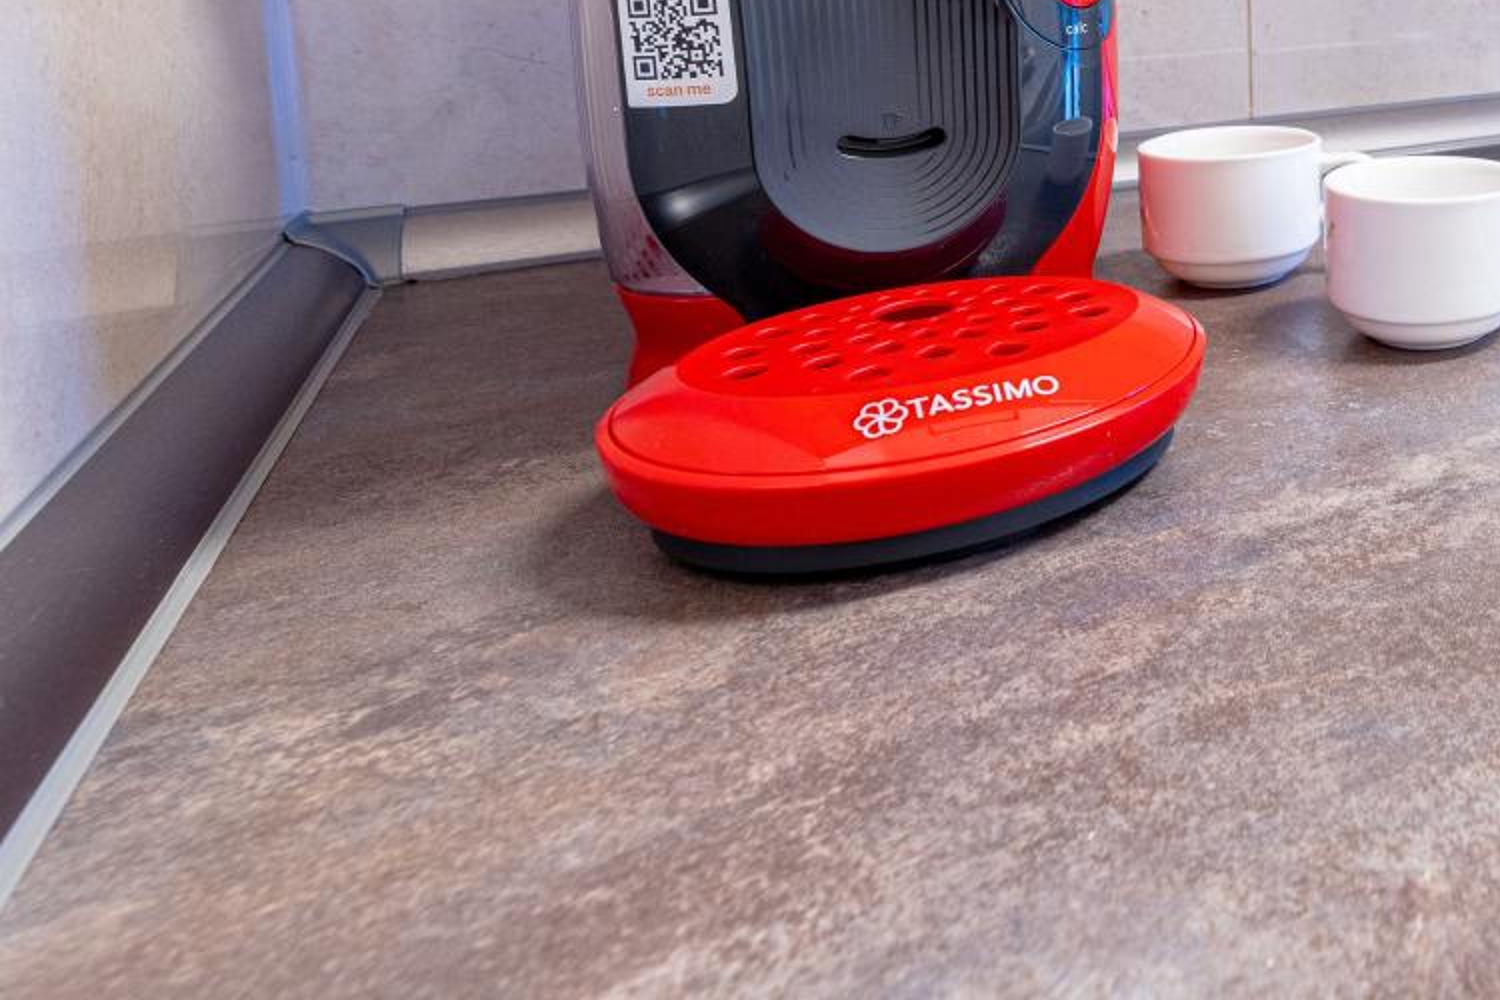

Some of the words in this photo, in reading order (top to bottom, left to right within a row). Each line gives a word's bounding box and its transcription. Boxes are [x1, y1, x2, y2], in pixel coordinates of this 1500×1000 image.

[647, 85, 684, 97] scan
[687, 84, 712, 96] me
[905, 375, 1060, 419] TASSIMO
